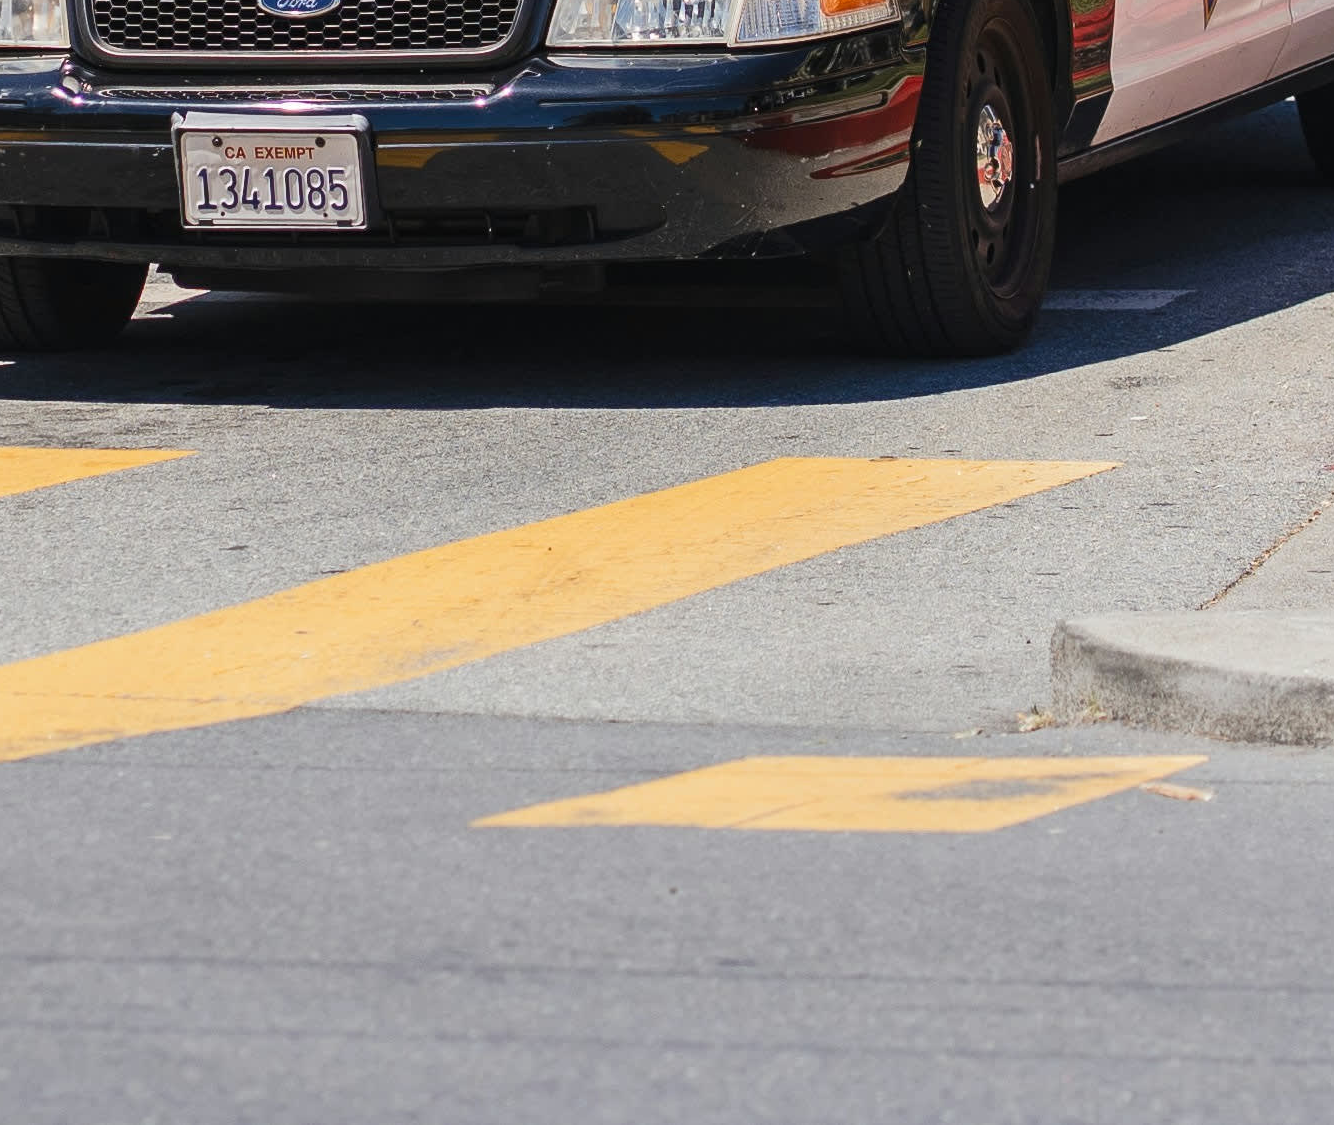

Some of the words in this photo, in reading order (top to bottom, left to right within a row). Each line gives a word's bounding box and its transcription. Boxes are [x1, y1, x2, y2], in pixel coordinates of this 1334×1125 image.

[225, 146, 247, 160] CA
[254, 146, 315, 160] EXEMPT
[197, 167, 349, 211] 1341085
